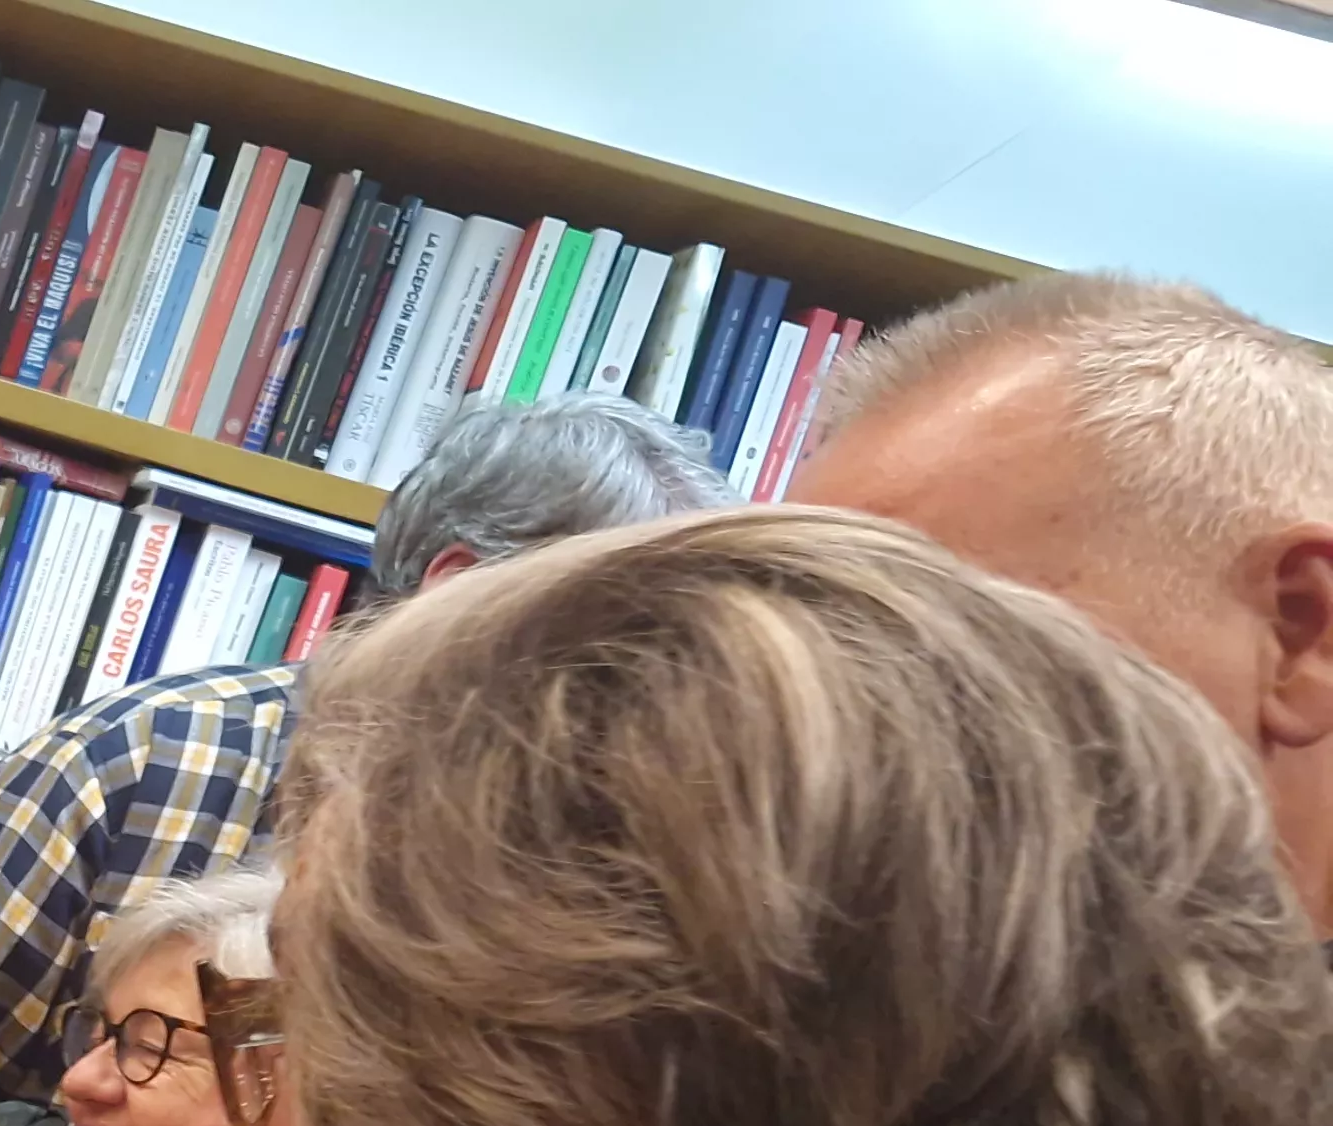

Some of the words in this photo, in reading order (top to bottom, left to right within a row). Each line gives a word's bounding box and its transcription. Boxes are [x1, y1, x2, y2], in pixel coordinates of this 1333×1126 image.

[423, 231, 442, 251] LA
[41, 252, 79, 311] MAQUIS!
[397, 249, 437, 324] EXCEPCIÓN
[35, 309, 58, 330] EL
[21, 329, 55, 369] ¡VIVA
[378, 321, 410, 374] IBÉRICA
[101, 594, 145, 680] CARLOS
[129, 519, 171, 595] SAURA
